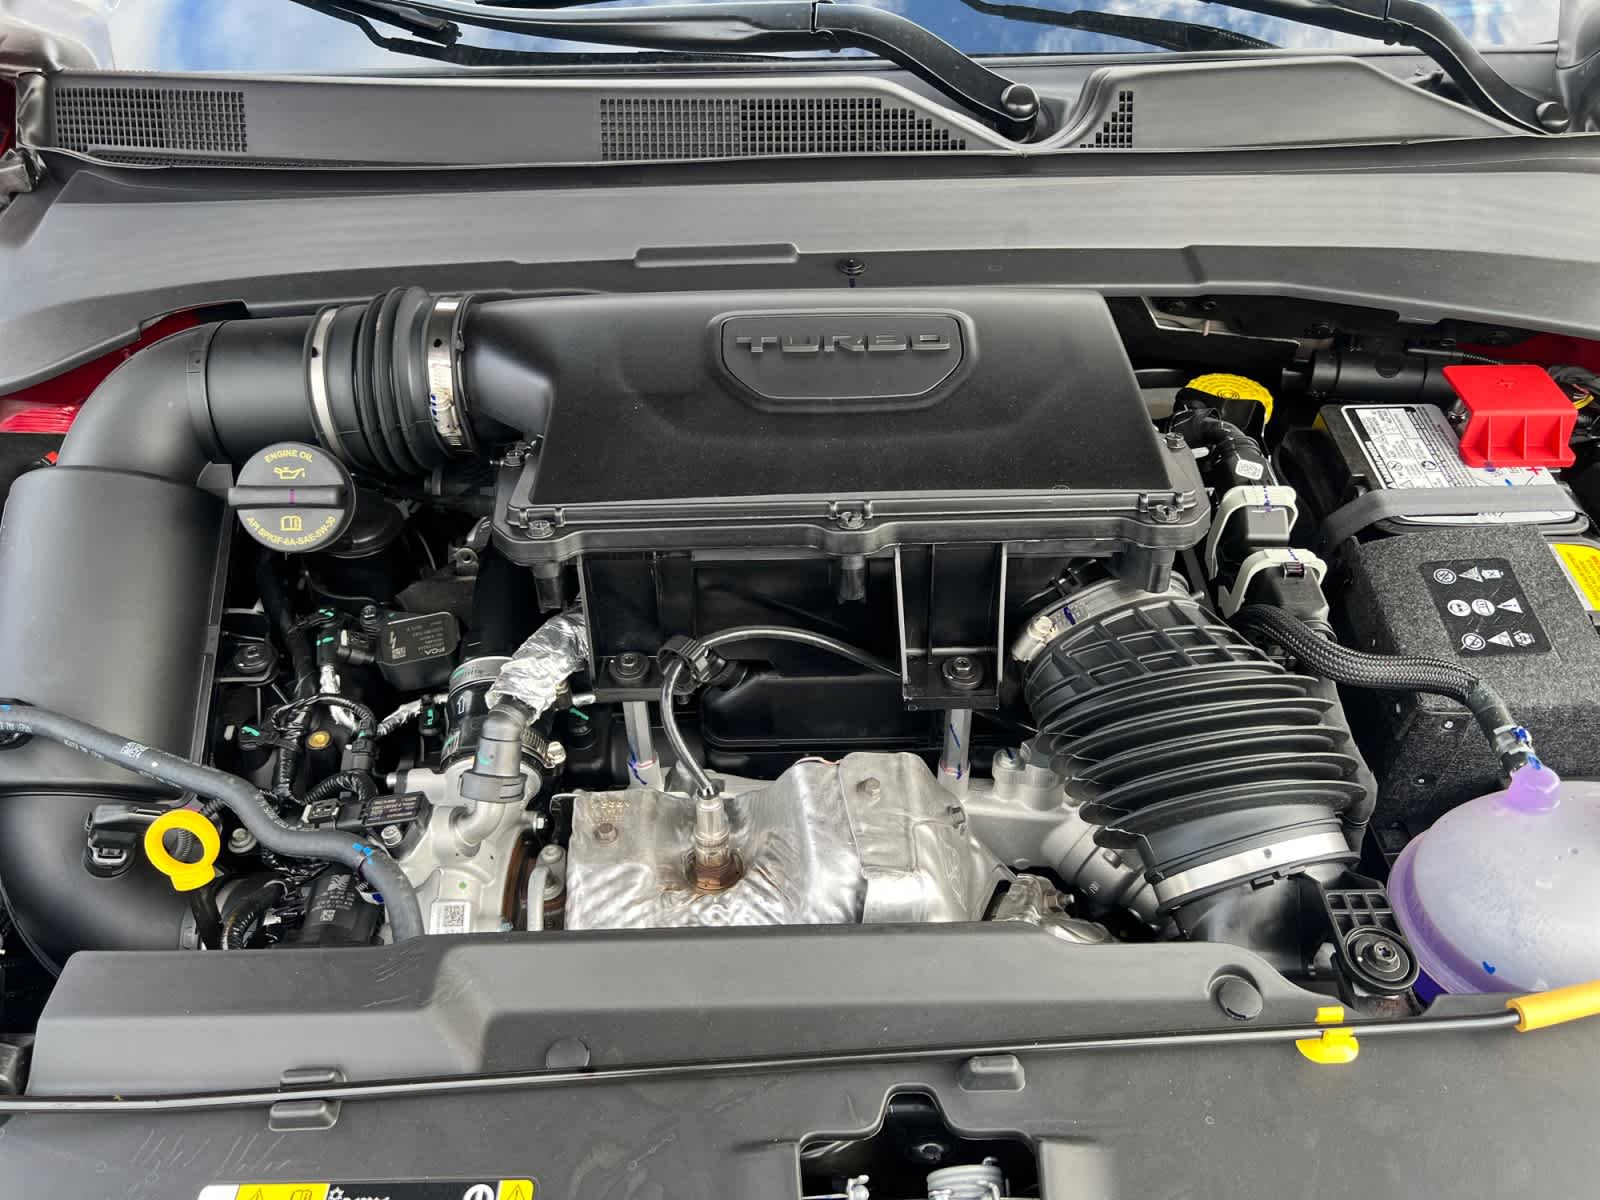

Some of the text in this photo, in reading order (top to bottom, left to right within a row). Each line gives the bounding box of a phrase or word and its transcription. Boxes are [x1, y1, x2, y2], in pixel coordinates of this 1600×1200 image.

[736, 335, 950, 353] TURBO
[264, 449, 313, 463] ENGINE OIL
